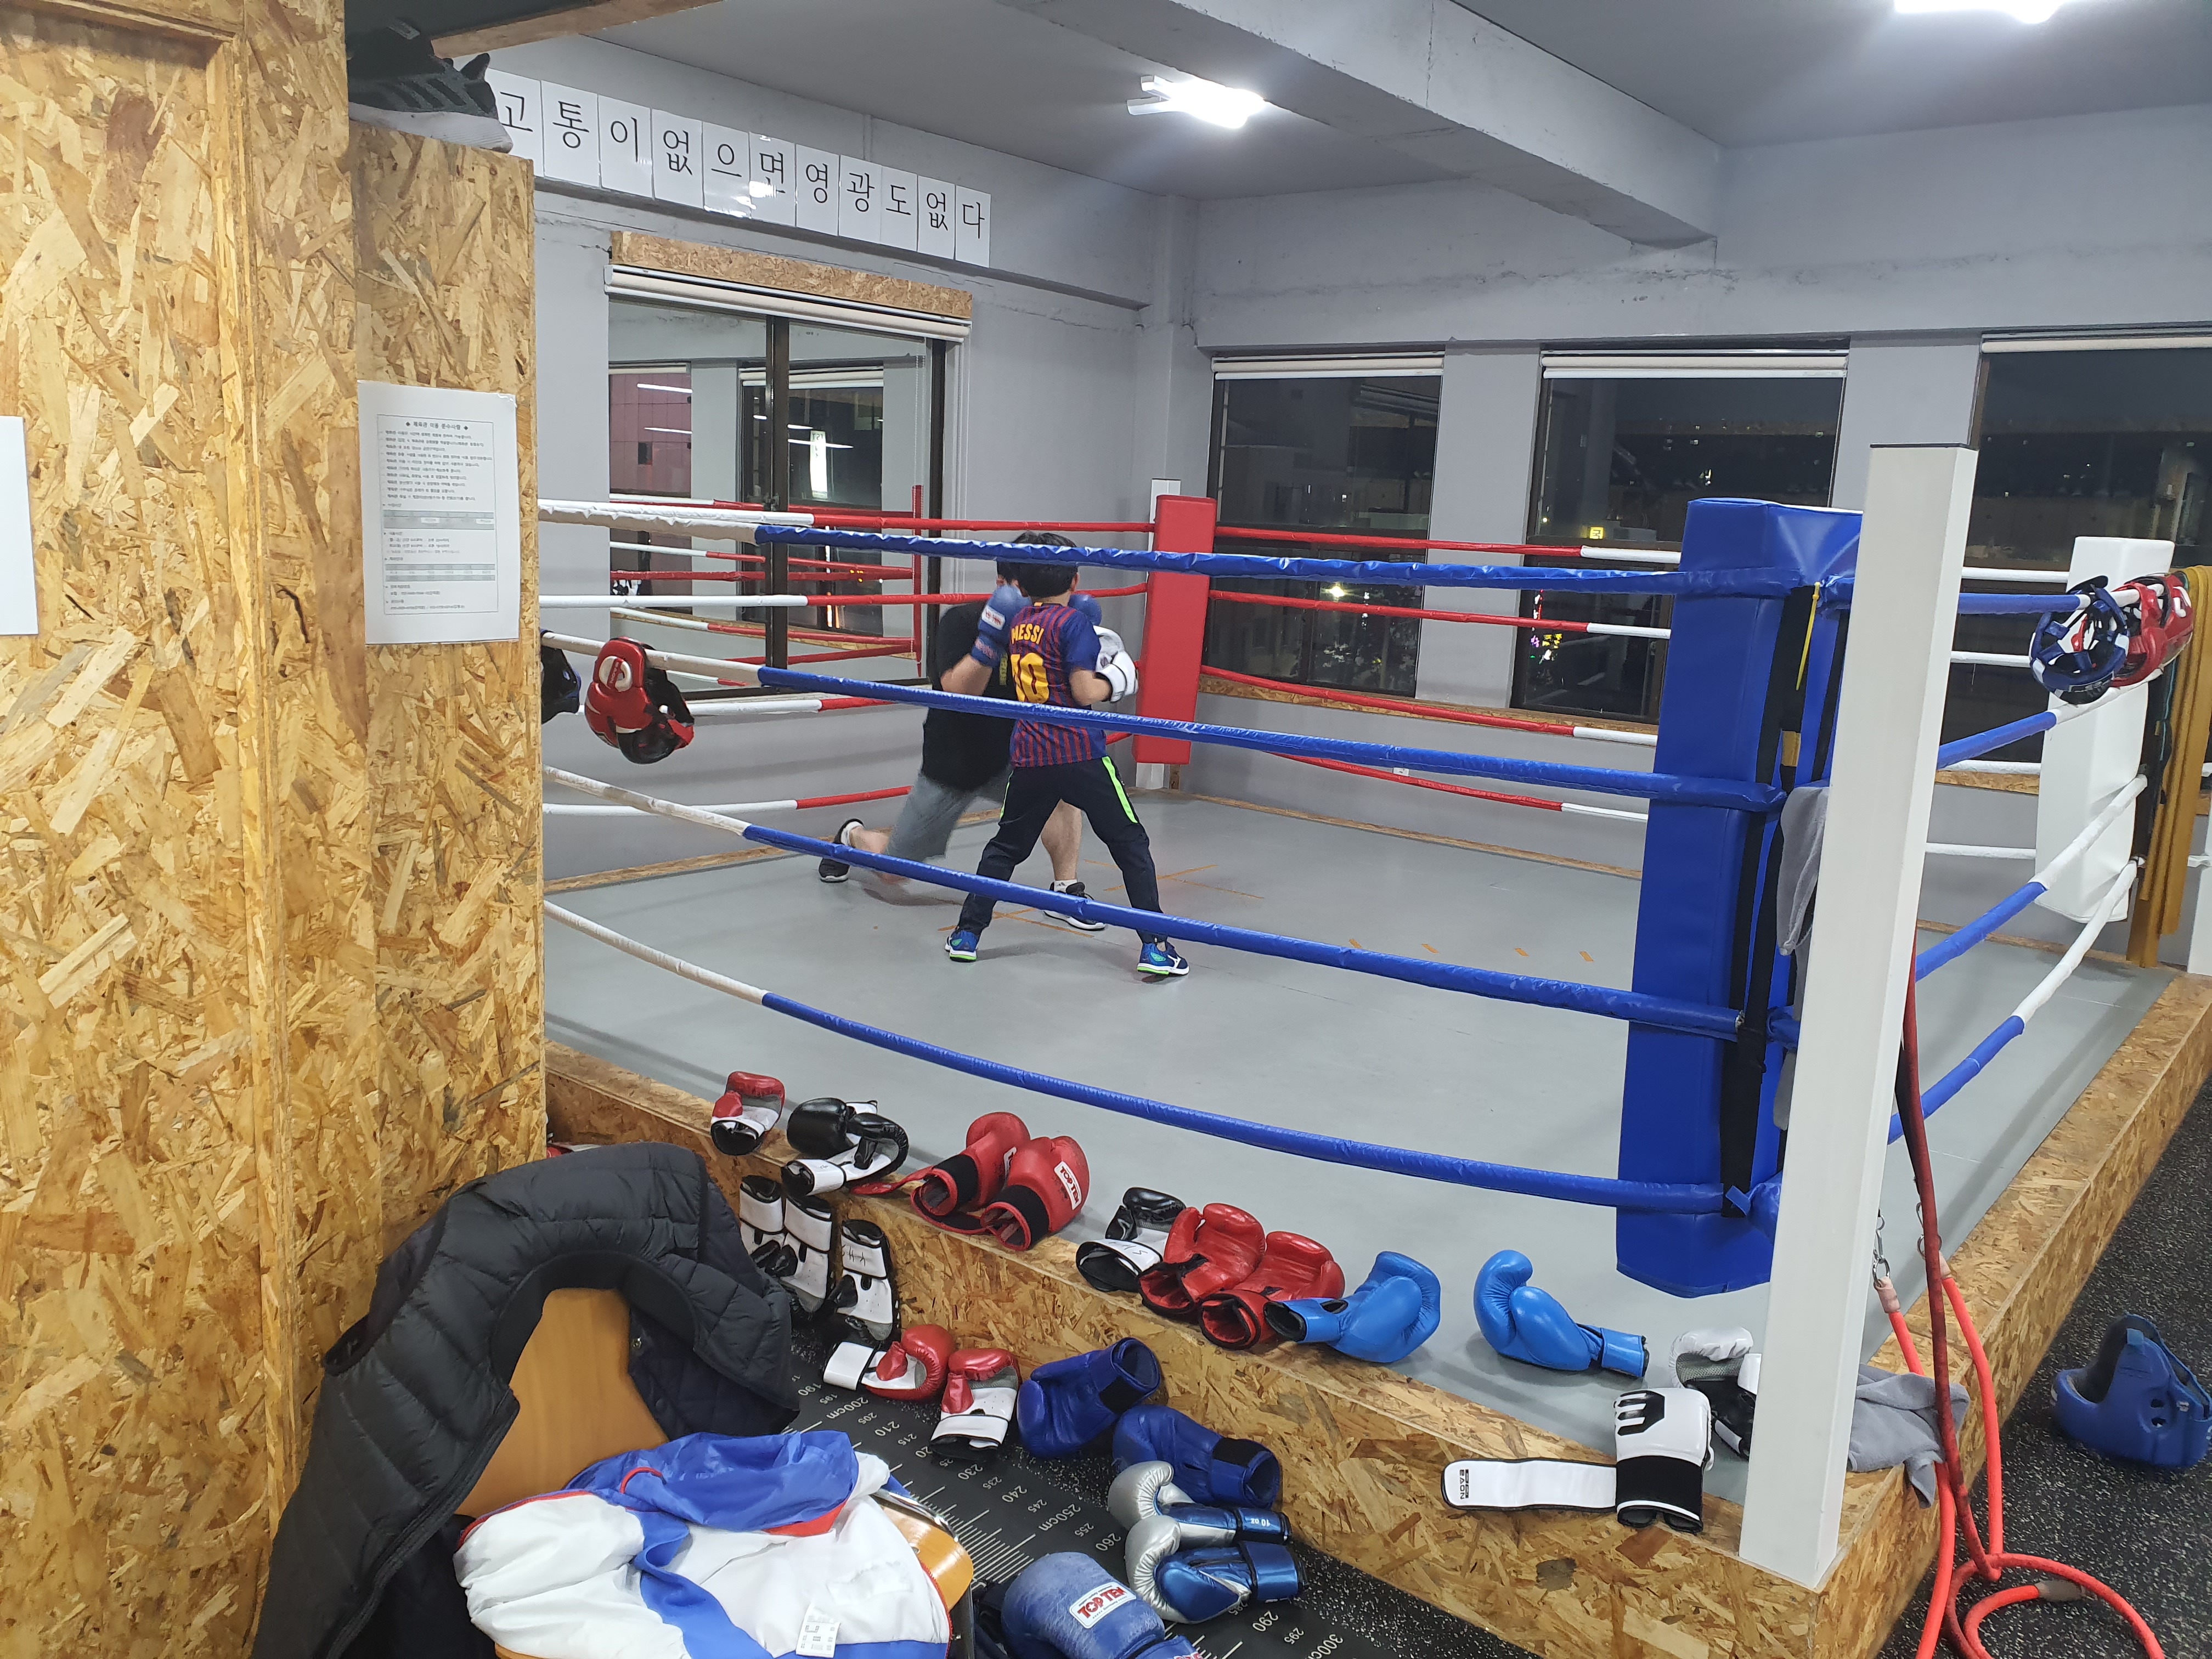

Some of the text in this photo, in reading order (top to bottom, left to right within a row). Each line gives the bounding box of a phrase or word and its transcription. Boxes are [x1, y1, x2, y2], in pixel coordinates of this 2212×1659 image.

[1011, 623, 1045, 645] MESSI
[1011, 652, 1050, 704] 10
[1060, 1166, 1080, 1204] TOP TEN
[798, 1383, 821, 1396] 190
[819, 1393, 838, 1404] 195
[826, 1397, 869, 1420] 200cm
[857, 1412, 877, 1425] 205
[874, 1421, 900, 1437] 210
[898, 1433, 917, 1446] 215
[915, 1446, 933, 1458] 20
[958, 1464, 983, 1480] 230
[983, 1476, 1002, 1489] 235
[1002, 1485, 1028, 1503] 240
[1028, 1499, 1047, 1513] 245
[1038, 1503, 1081, 1532] 250cm
[1261, 1519, 1271, 1527] 10
[1074, 1522, 1094, 1537] 255
[1095, 1532, 1121, 1551] 260
[1077, 1597, 1104, 1619] TOP
[1099, 1586, 1127, 1602] TEN
[1252, 1610, 1279, 1632] 290
[1284, 1627, 1305, 1645] 295
[1305, 1634, 1344, 1659] 300c
